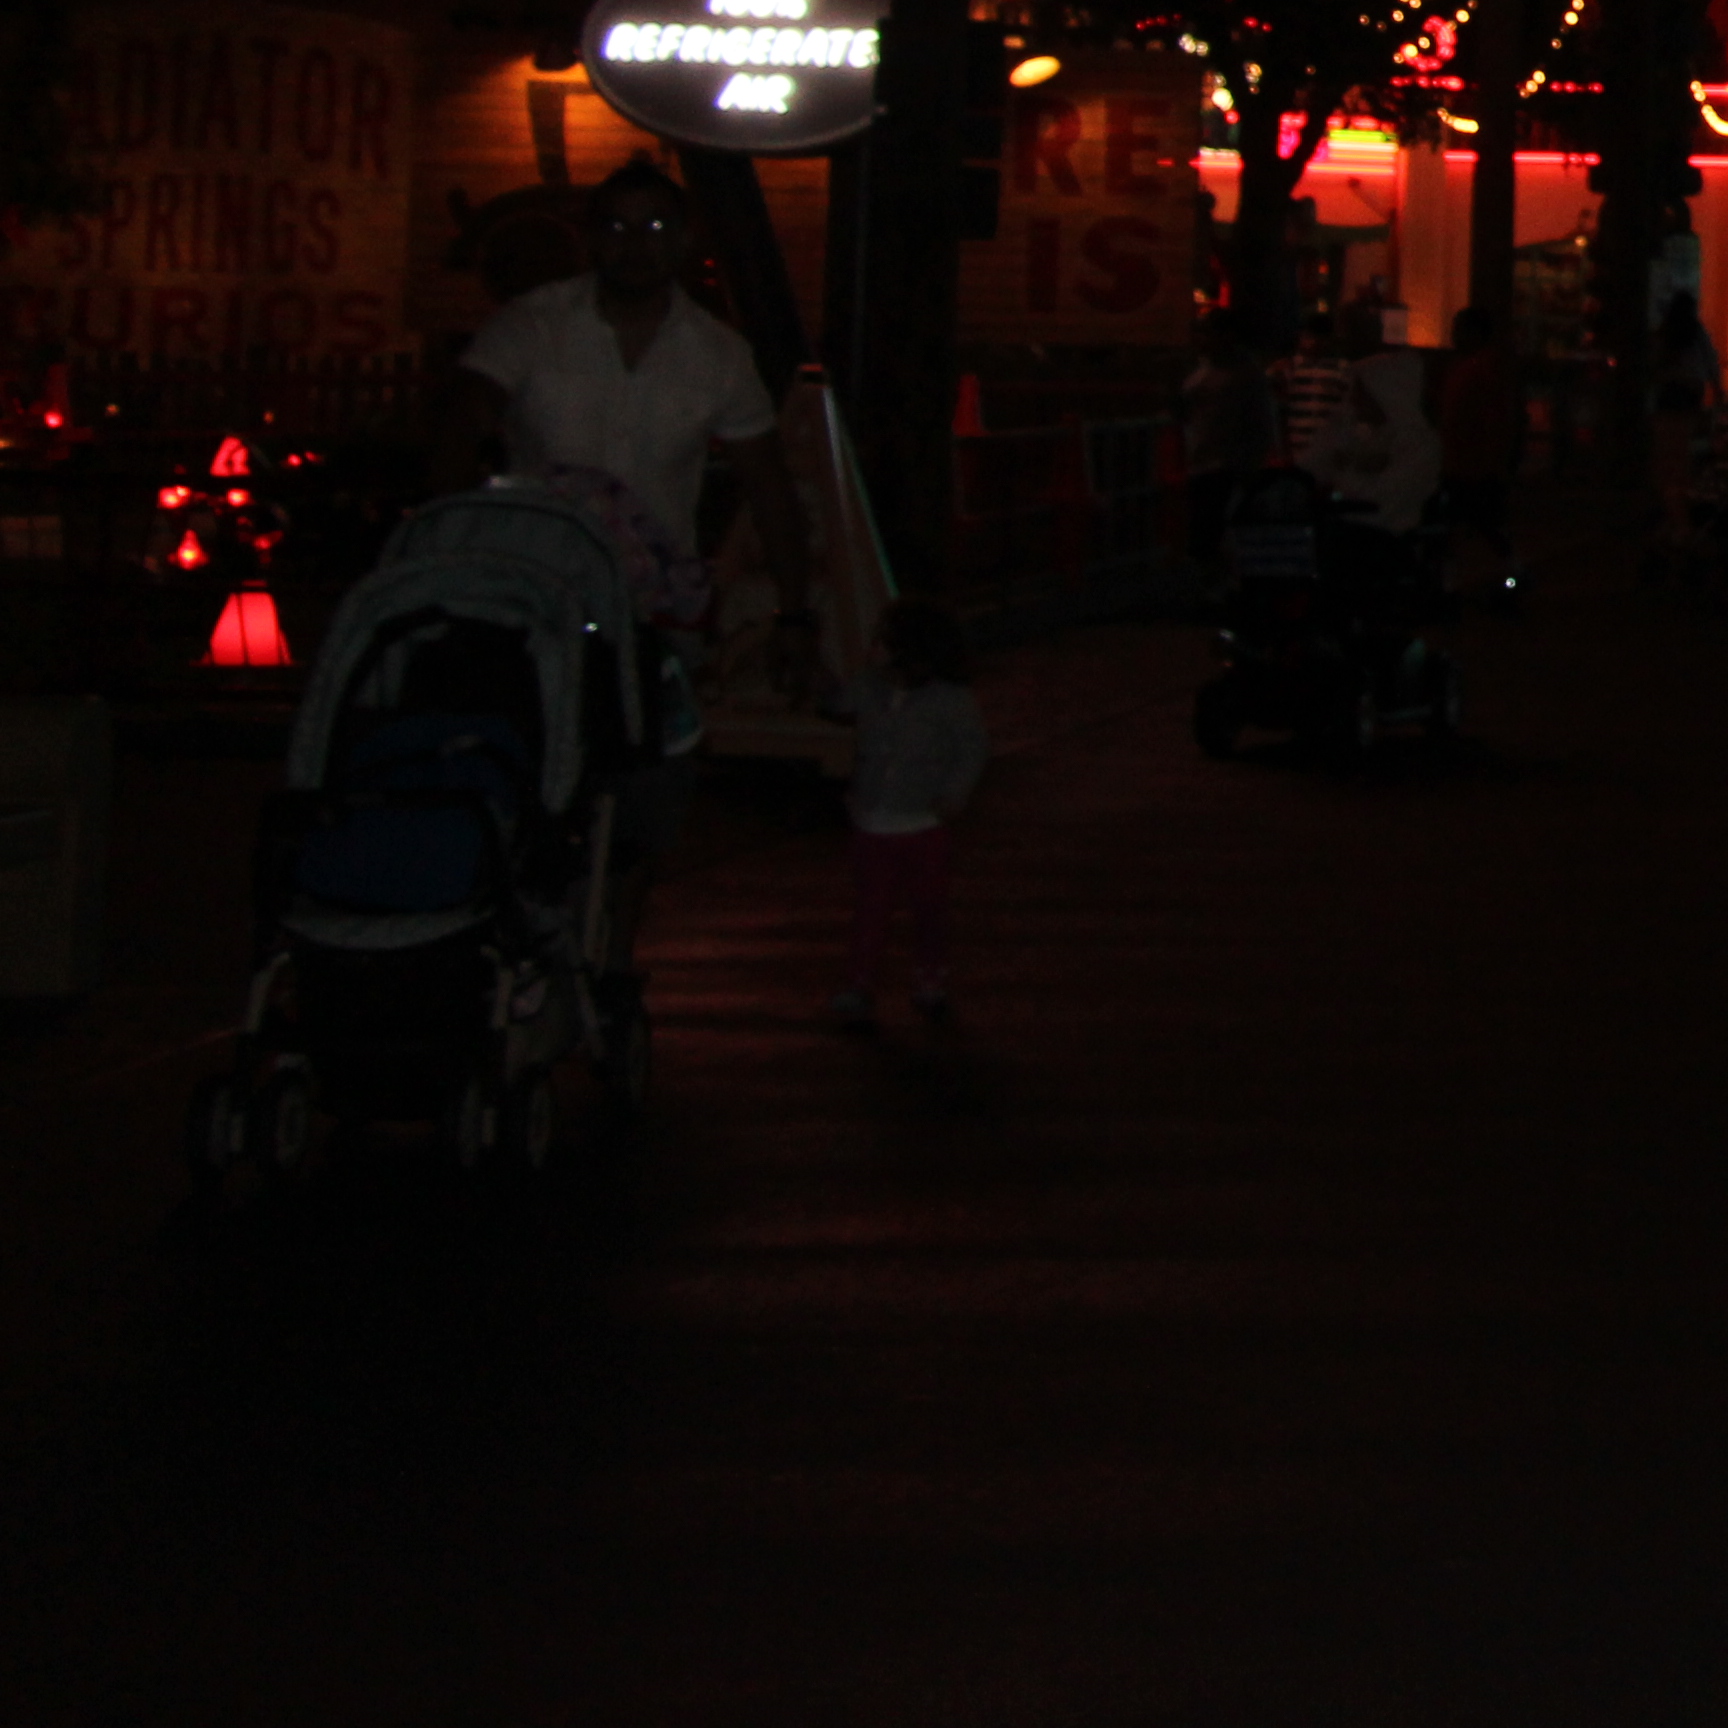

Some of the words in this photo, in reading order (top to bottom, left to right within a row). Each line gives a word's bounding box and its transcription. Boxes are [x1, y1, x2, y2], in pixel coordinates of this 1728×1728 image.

[601, 23, 880, 69] REFRIGERATE
[60, 35, 392, 179] ADIATOR
[714, 72, 795, 114] AIR
[55, 172, 342, 278] SPRINGS
